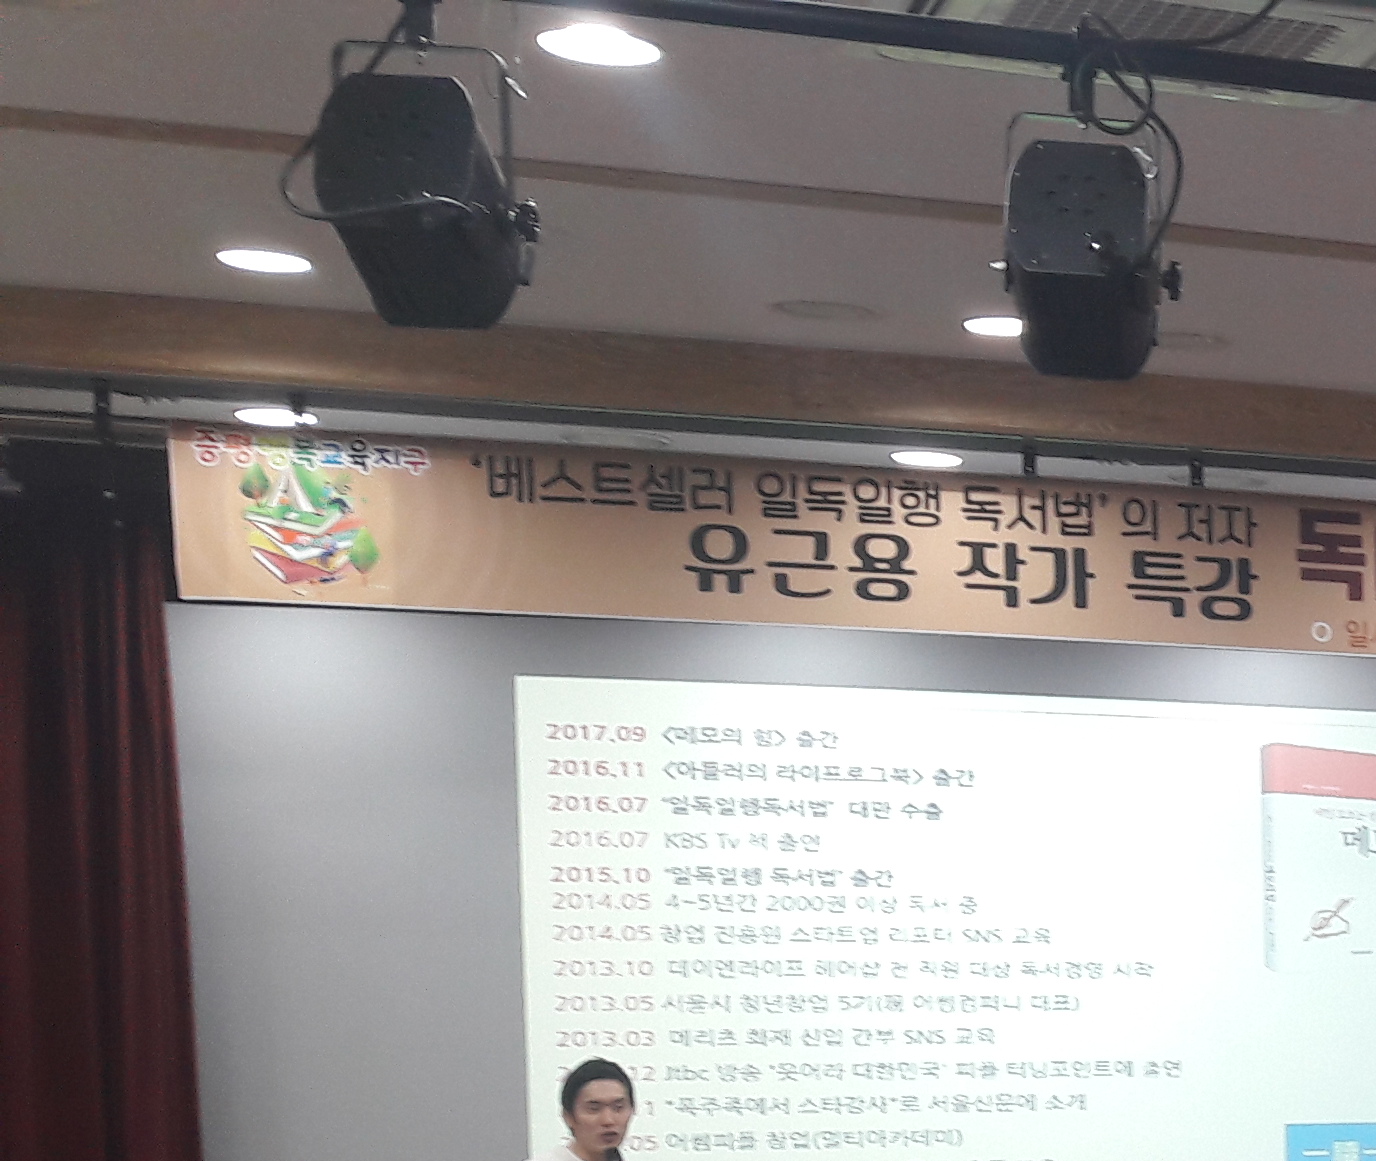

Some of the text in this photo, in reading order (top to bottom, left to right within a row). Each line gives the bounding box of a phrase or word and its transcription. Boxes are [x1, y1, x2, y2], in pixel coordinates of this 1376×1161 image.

[756, 470, 941, 528] 일독일행
[1122, 498, 1160, 541] 의
[1177, 503, 1258, 548] 저자
[684, 524, 1259, 621] 유근용 작가 특강
[545, 724, 646, 742] 2017.09
[547, 760, 644, 777] 2016.11
[664, 832, 708, 849] KBS
[550, 867, 650, 883] 2015.10
[903, 1030, 946, 1044] SNS
